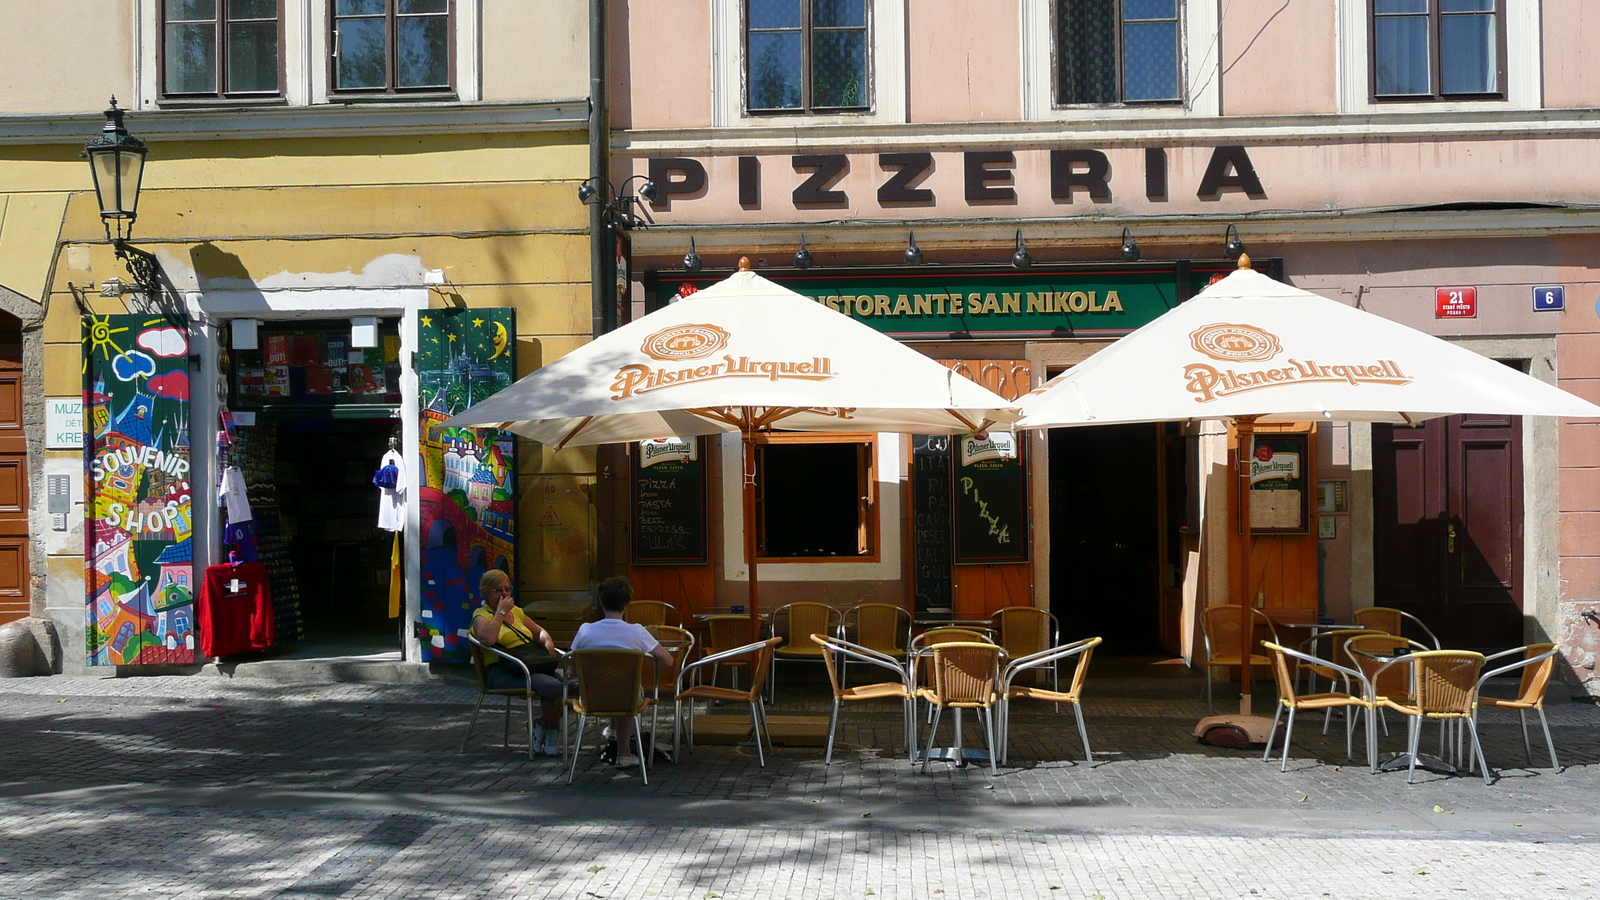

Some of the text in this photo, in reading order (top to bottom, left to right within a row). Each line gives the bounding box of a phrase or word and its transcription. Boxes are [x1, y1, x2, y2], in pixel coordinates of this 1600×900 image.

[648, 146, 1266, 207] PIZZERIA
[806, 291, 1124, 316] STORANTE SAN NIKOLA
[1449, 291, 1464, 304] 21
[1545, 291, 1554, 304] 6
[610, 354, 832, 401] Pilsner Urquell
[1182, 358, 1408, 403] Pilsner Urquell
[55, 403, 81, 414] MUZ
[56, 432, 82, 443] KRE
[646, 442, 691, 459] Pilsner Urquell
[967, 440, 1011, 457] Pilsner Urquell
[90, 445, 190, 481] SOUVENIR
[638, 498, 672, 510] PASTA
[960, 476, 1011, 544] PIZZA
[105, 503, 178, 533] SHOP
